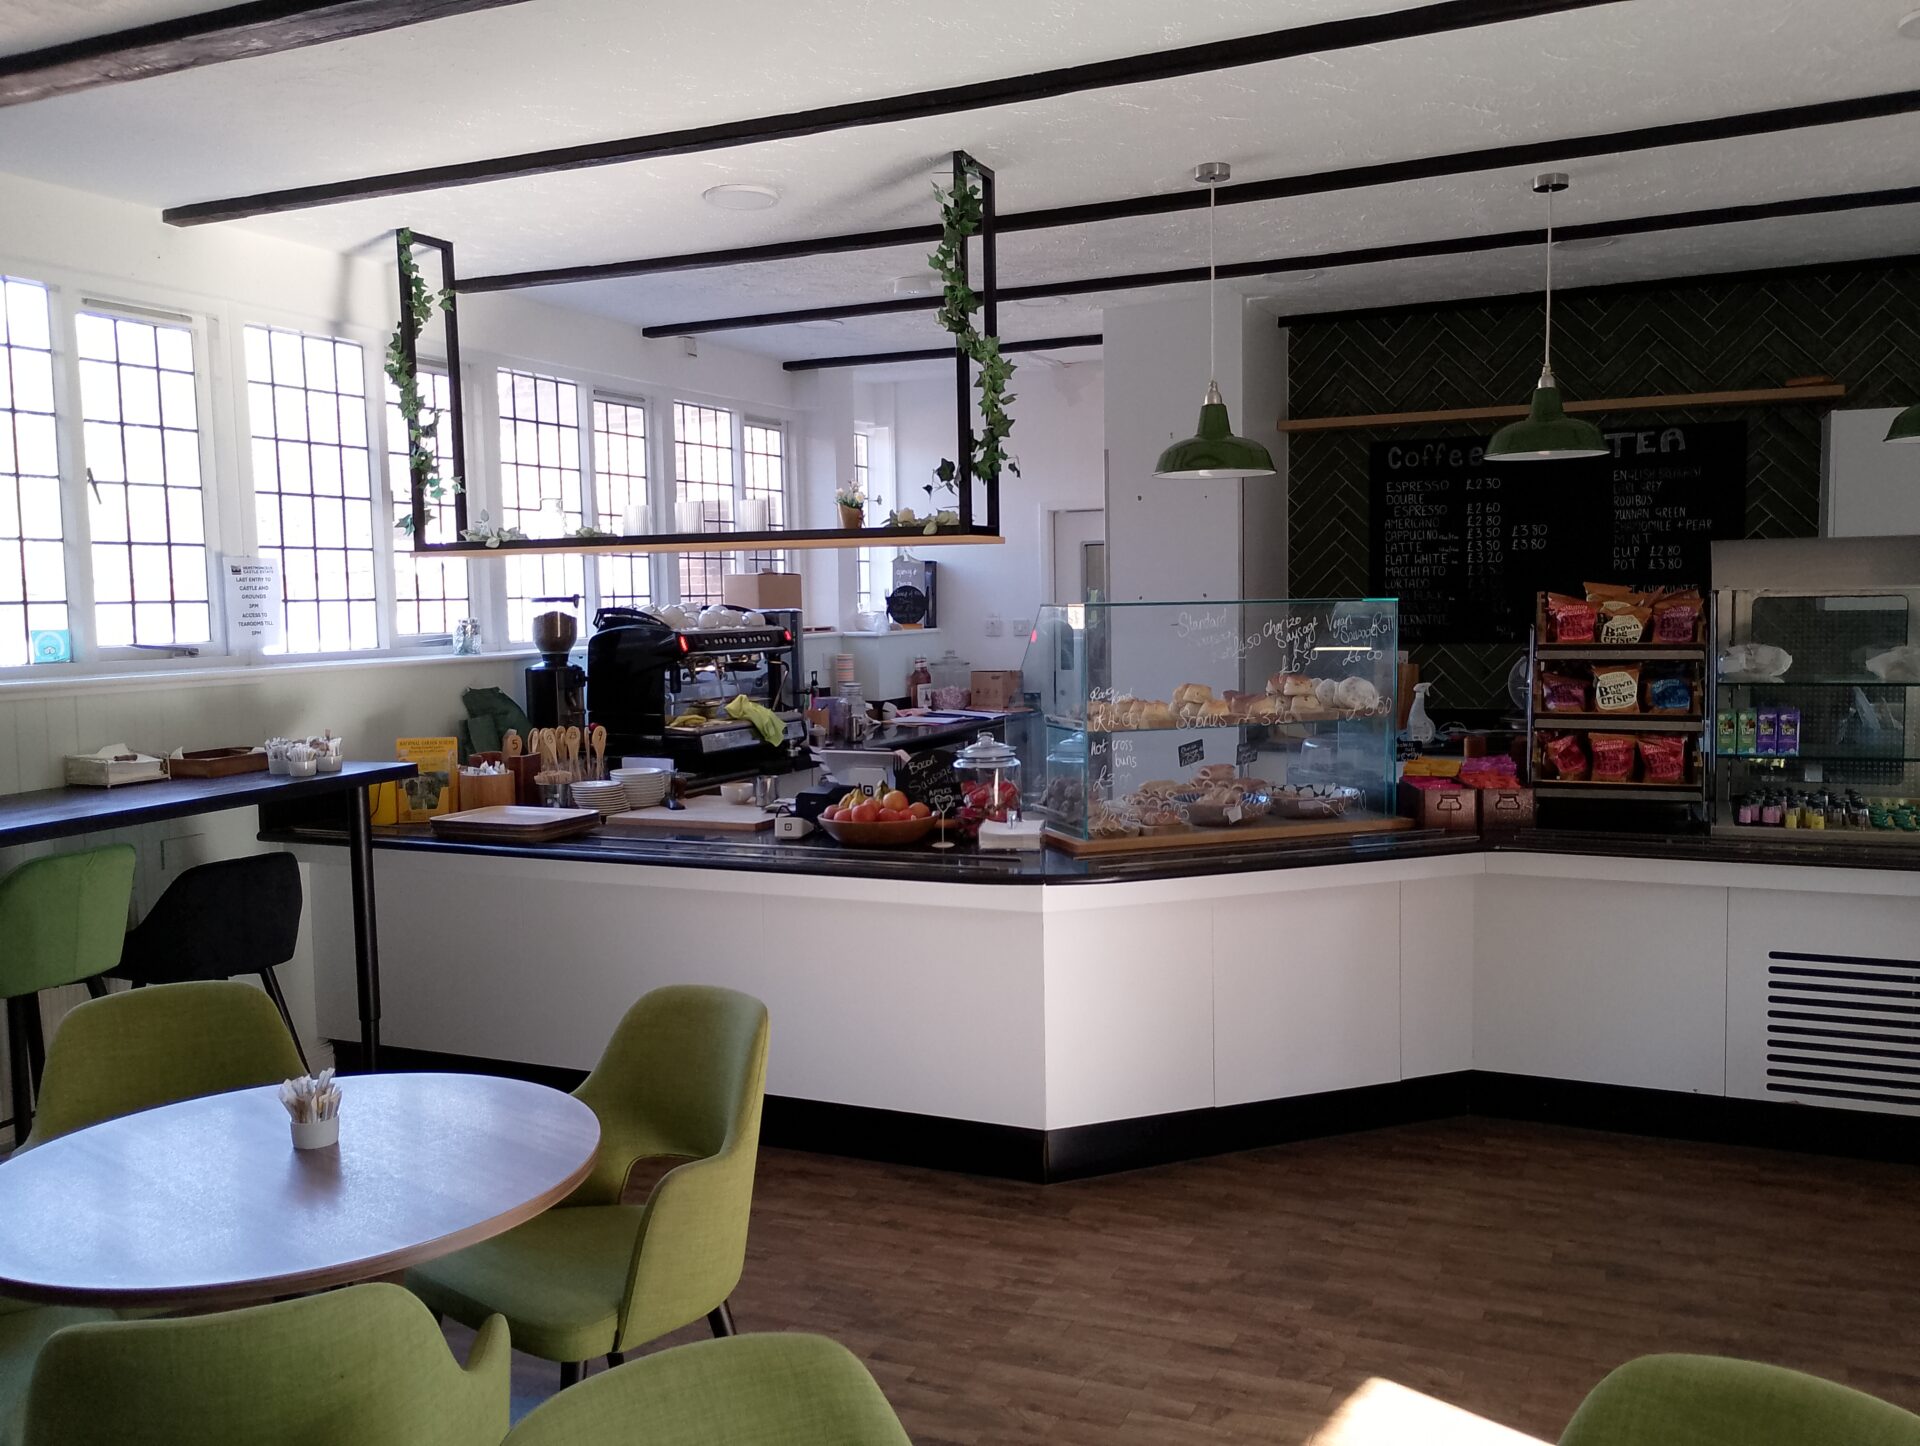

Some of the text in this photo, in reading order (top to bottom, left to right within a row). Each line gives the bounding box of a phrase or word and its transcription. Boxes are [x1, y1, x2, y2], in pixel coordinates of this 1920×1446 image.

[1603, 427, 1687, 458] TEA
[1387, 442, 1484, 470] Coffee
[1386, 480, 1450, 493] ESPRESSO
[1386, 493, 1425, 505] DOUBLE
[1613, 495, 1653, 507] ROOIBOS
[1394, 504, 1448, 517] ESPRESSO
[1655, 506, 1686, 518] GREEN
[1384, 518, 1440, 530] AMERICANO
[1384, 529, 1439, 542] CAPPUCINO
[1385, 542, 1422, 553] LATTE
[1613, 546, 1640, 559] CUP
[1385, 552, 1448, 565] FLAT WHITE
[1613, 559, 1636, 570] POT
[1385, 565, 1446, 577] MACCHIATO
[1605, 624, 1639, 637] Brown
[1599, 680, 1633, 697] Brown
[1601, 693, 1635, 705] crisps
[1176, 706, 1228, 730] Scones
[512, 739, 519, 750] 5
